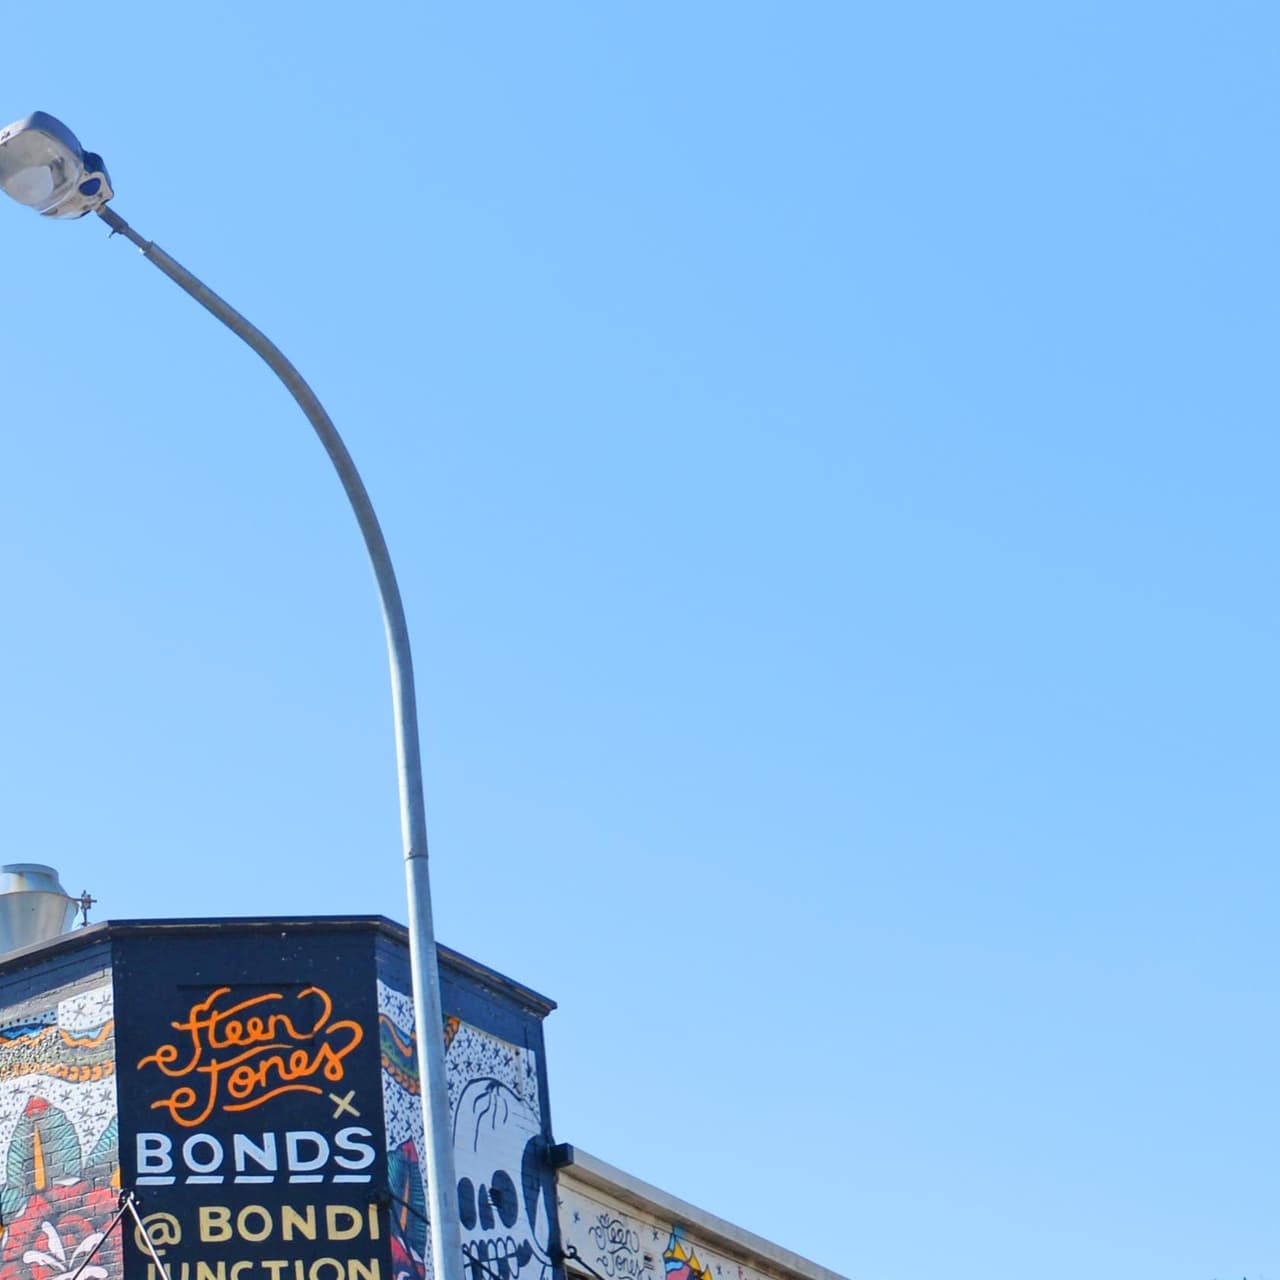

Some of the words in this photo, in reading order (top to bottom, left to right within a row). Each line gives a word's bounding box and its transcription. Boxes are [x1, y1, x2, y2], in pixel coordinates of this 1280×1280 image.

[135, 1126, 376, 1174] BONDS
[134, 1212, 182, 1257] @
[199, 1204, 381, 1242] BONDI
